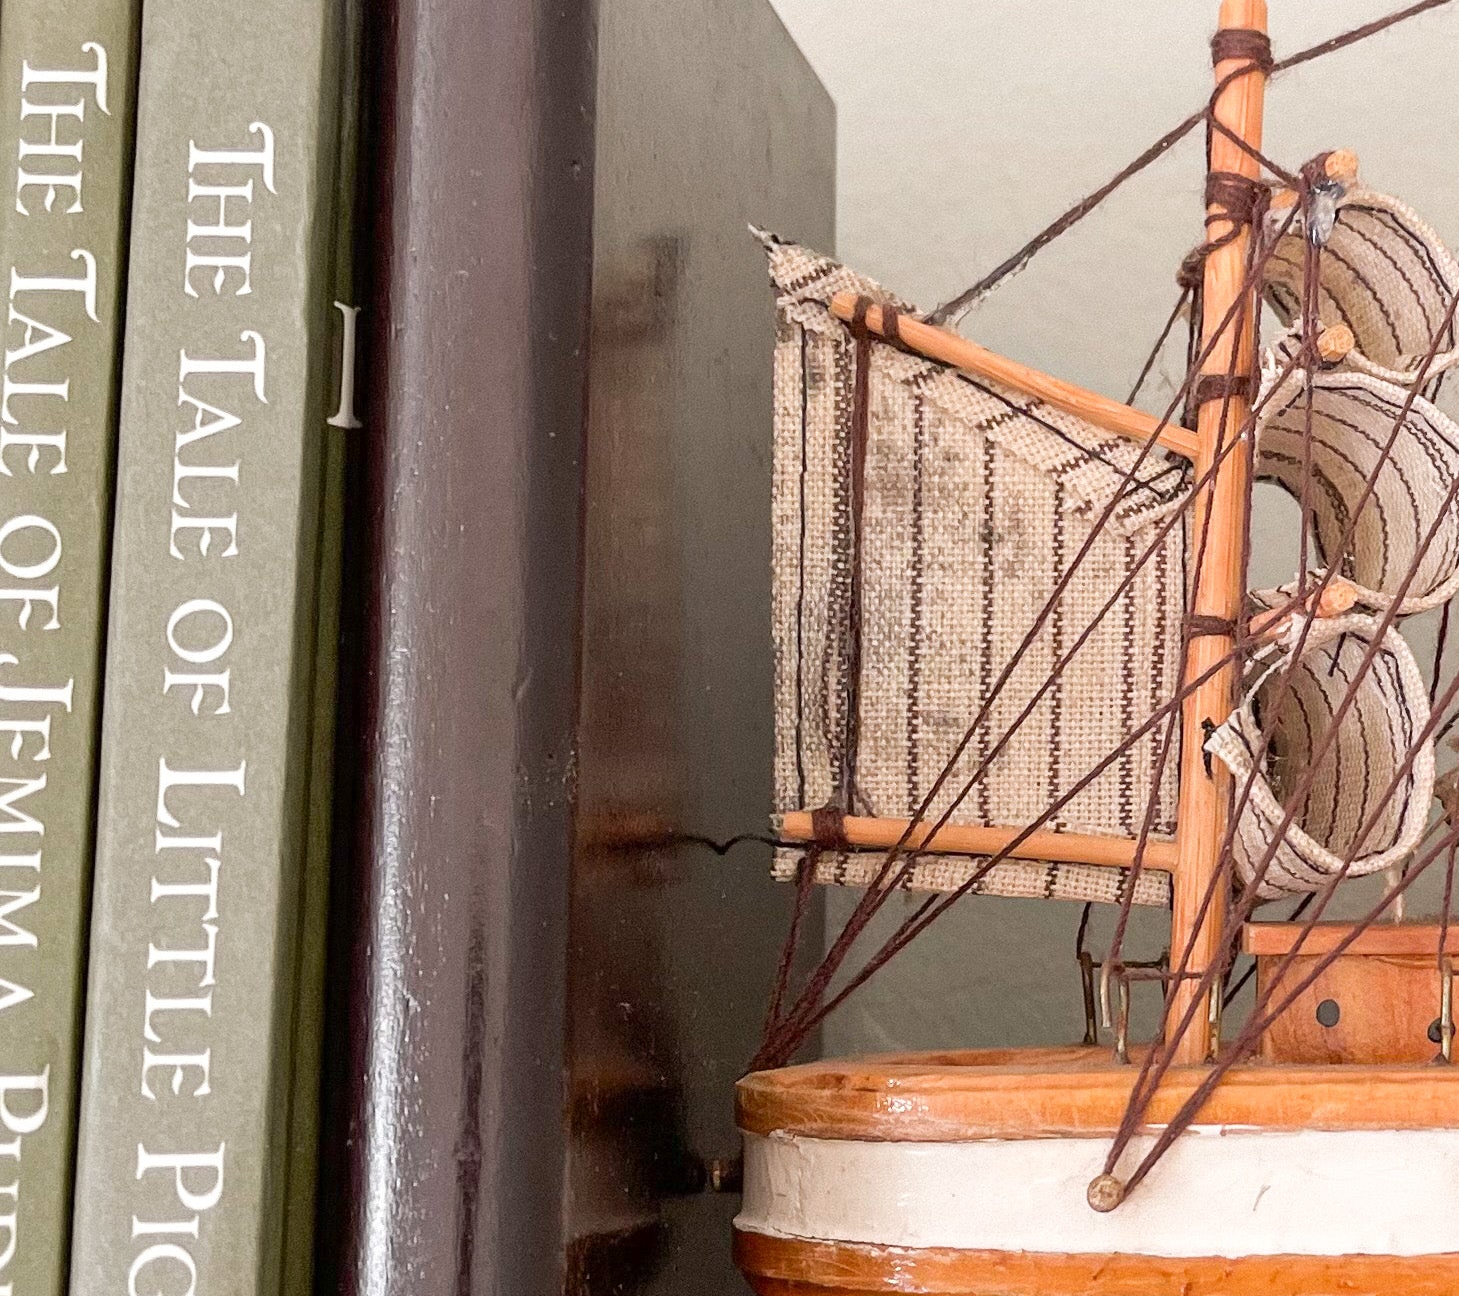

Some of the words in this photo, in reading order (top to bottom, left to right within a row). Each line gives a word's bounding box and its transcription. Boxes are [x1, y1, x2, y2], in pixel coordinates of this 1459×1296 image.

[15, 41, 112, 216] THE
[183, 121, 278, 299] THE
[0, 248, 101, 477] TALE
[169, 329, 269, 561] TALE
[0, 514, 63, 631] OF
[162, 598, 234, 716] OF
[140, 757, 247, 1100] LITTLE
